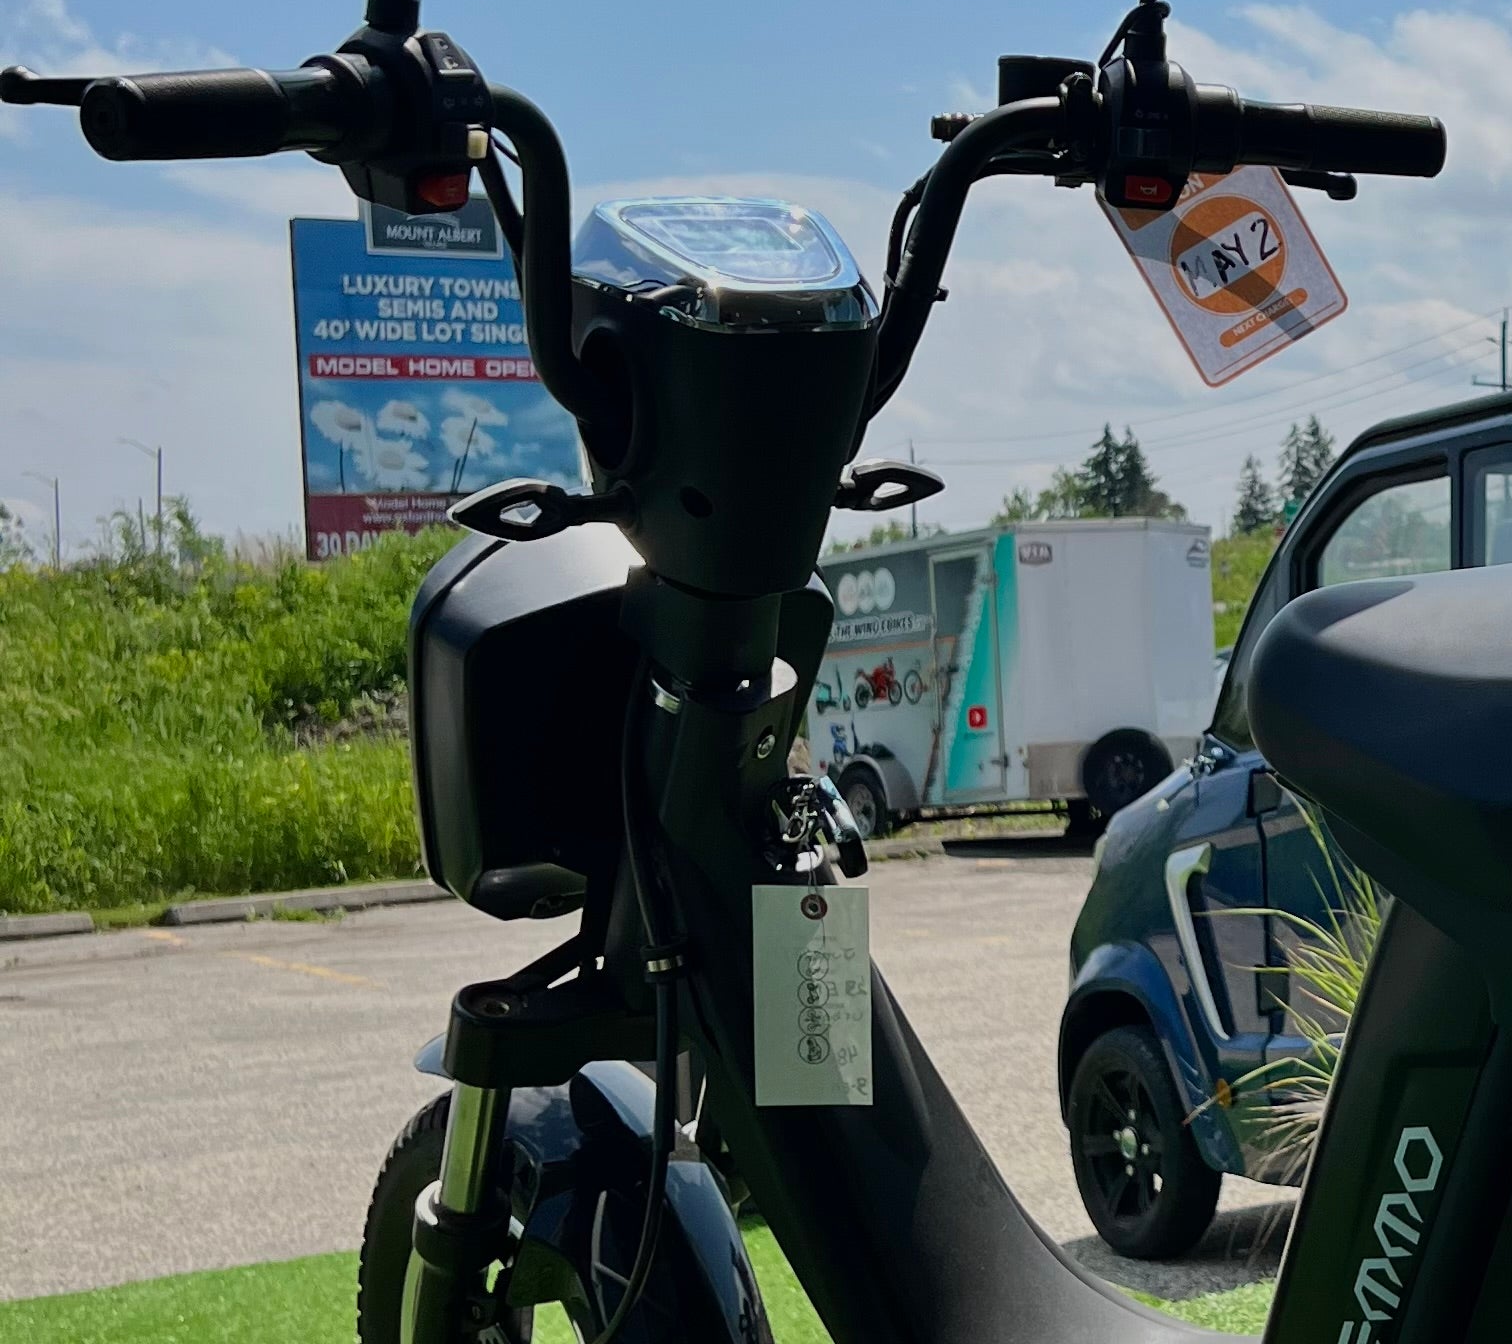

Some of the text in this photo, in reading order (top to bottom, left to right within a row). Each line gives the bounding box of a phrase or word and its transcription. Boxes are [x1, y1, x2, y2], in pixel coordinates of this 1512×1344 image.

[386, 224, 482, 244] MOUNT ALBERT
[1181, 218, 1282, 296] MAY 2
[342, 274, 434, 297] LUXURY
[378, 298, 499, 322] SEMIS AND
[313, 319, 350, 340] 40'
[355, 320, 417, 341] WIDE
[422, 322, 465, 343] LOT
[316, 356, 399, 376] MODEL
[408, 358, 476, 377] HOME
